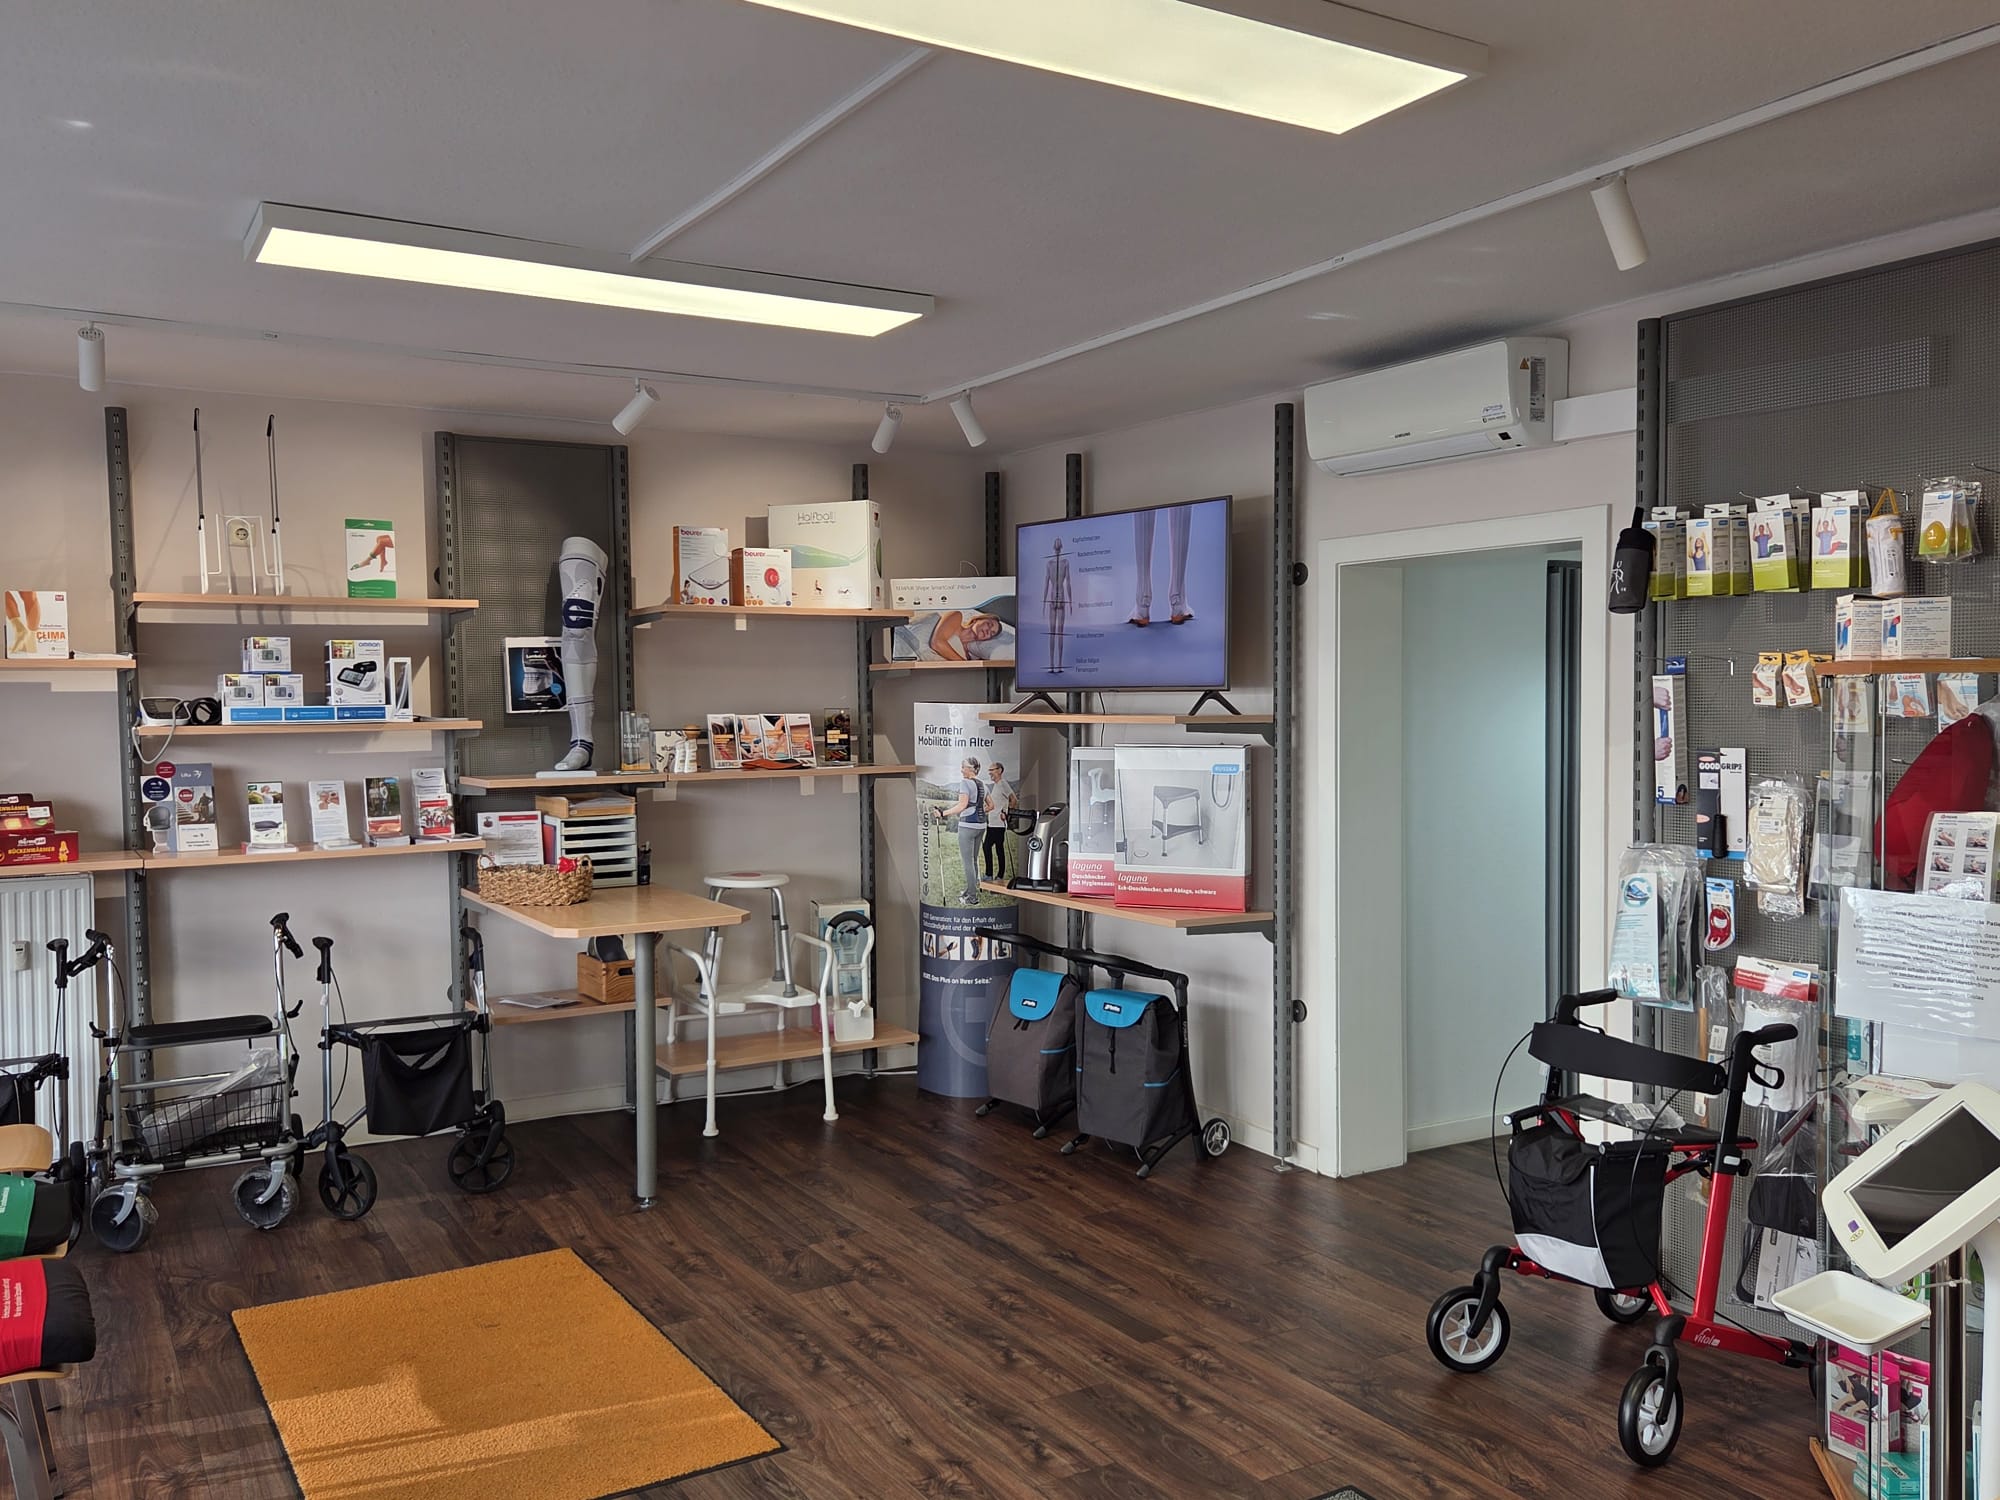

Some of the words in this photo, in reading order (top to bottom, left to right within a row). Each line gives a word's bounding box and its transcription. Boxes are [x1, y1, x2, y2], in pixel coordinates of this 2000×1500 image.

[36, 631, 65, 640] CLIMA
[925, 724, 938, 735] Für
[939, 725, 963, 735] mehr
[918, 735, 952, 747] Mobilität
[954, 737, 967, 747] im
[969, 737, 994, 748] Alter
[1699, 762, 1720, 770] GOOD
[1657, 786, 1665, 798] 5
[1072, 860, 1103, 872] laguna
[1118, 873, 1149, 885] laguna
[940, 976, 950, 984] Plus
